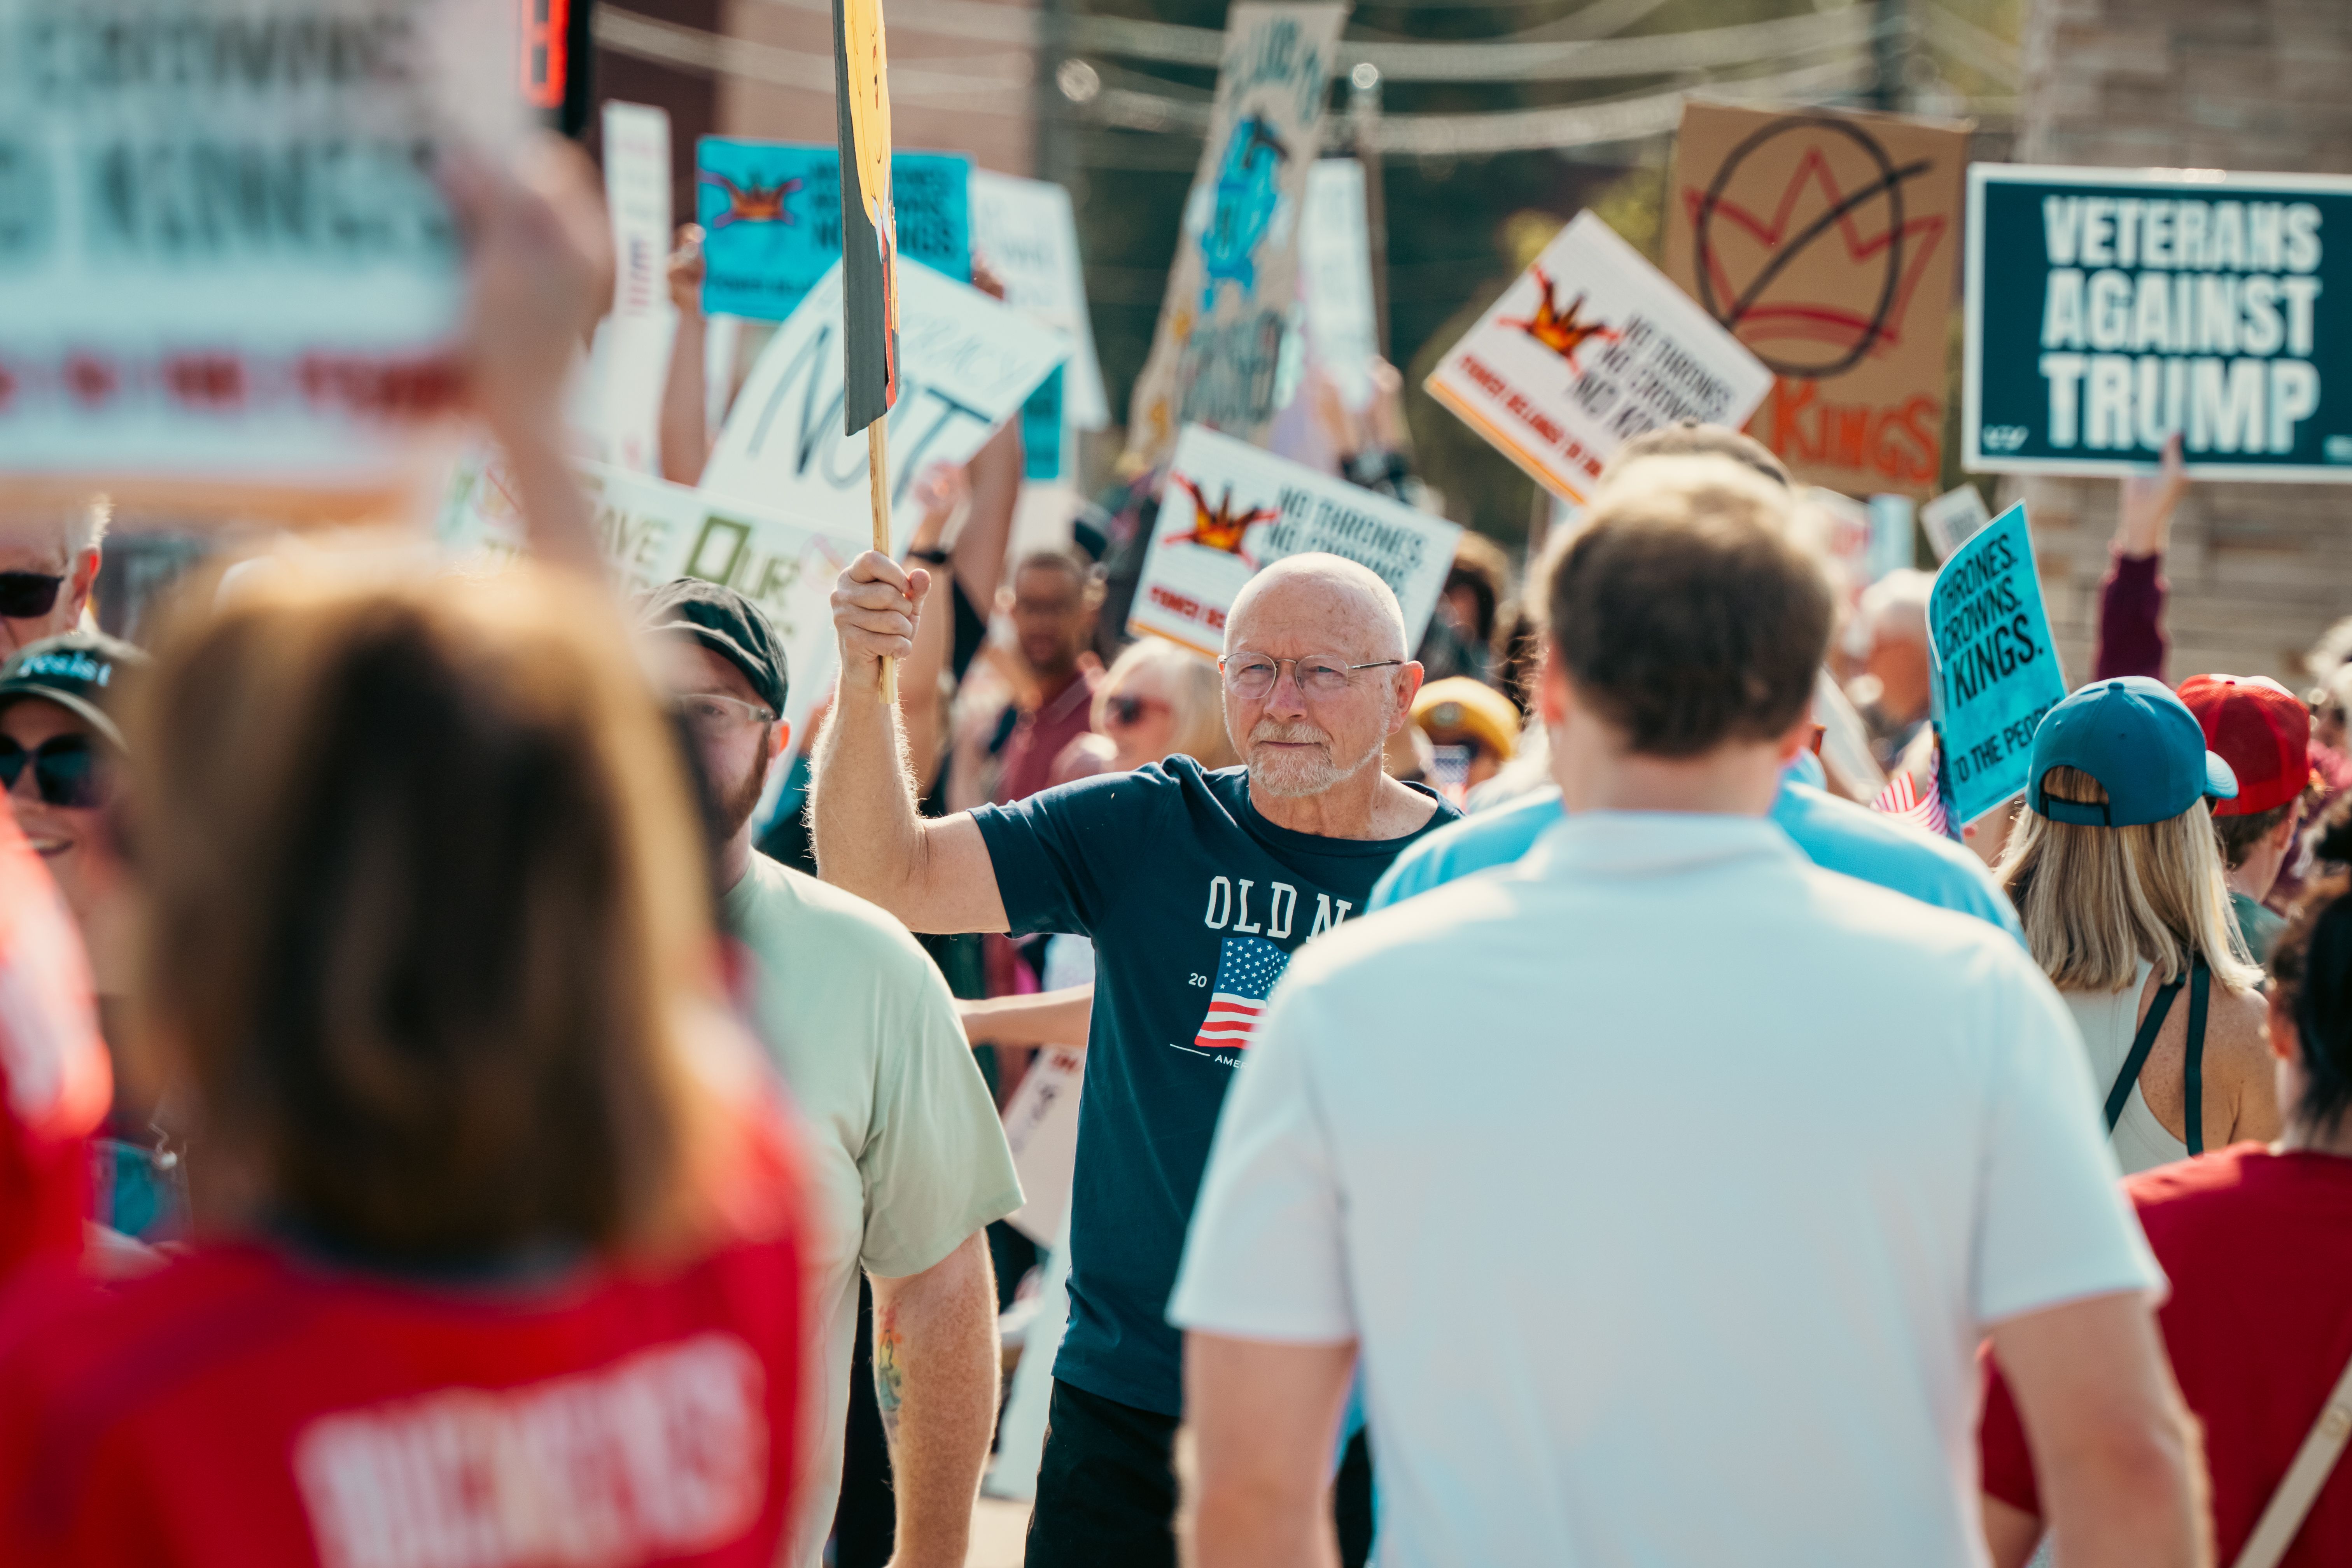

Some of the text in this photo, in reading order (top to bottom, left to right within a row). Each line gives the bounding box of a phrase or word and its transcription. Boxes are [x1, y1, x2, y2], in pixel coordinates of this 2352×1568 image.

[2042, 194, 2324, 274] VETERANS
[2039, 266, 2324, 358] AGAINST
[747, 321, 996, 510] NOT
[1773, 374, 1941, 486] KINGS
[2038, 351, 2322, 455] TRUMP
[683, 514, 801, 609] OUR
[1952, 612, 2044, 708] KINGS.
[1970, 733, 2004, 774] THE
[1204, 875, 1298, 939] OLD
[1188, 972, 1207, 988] 20
[1214, 1054, 1248, 1069] AMER
